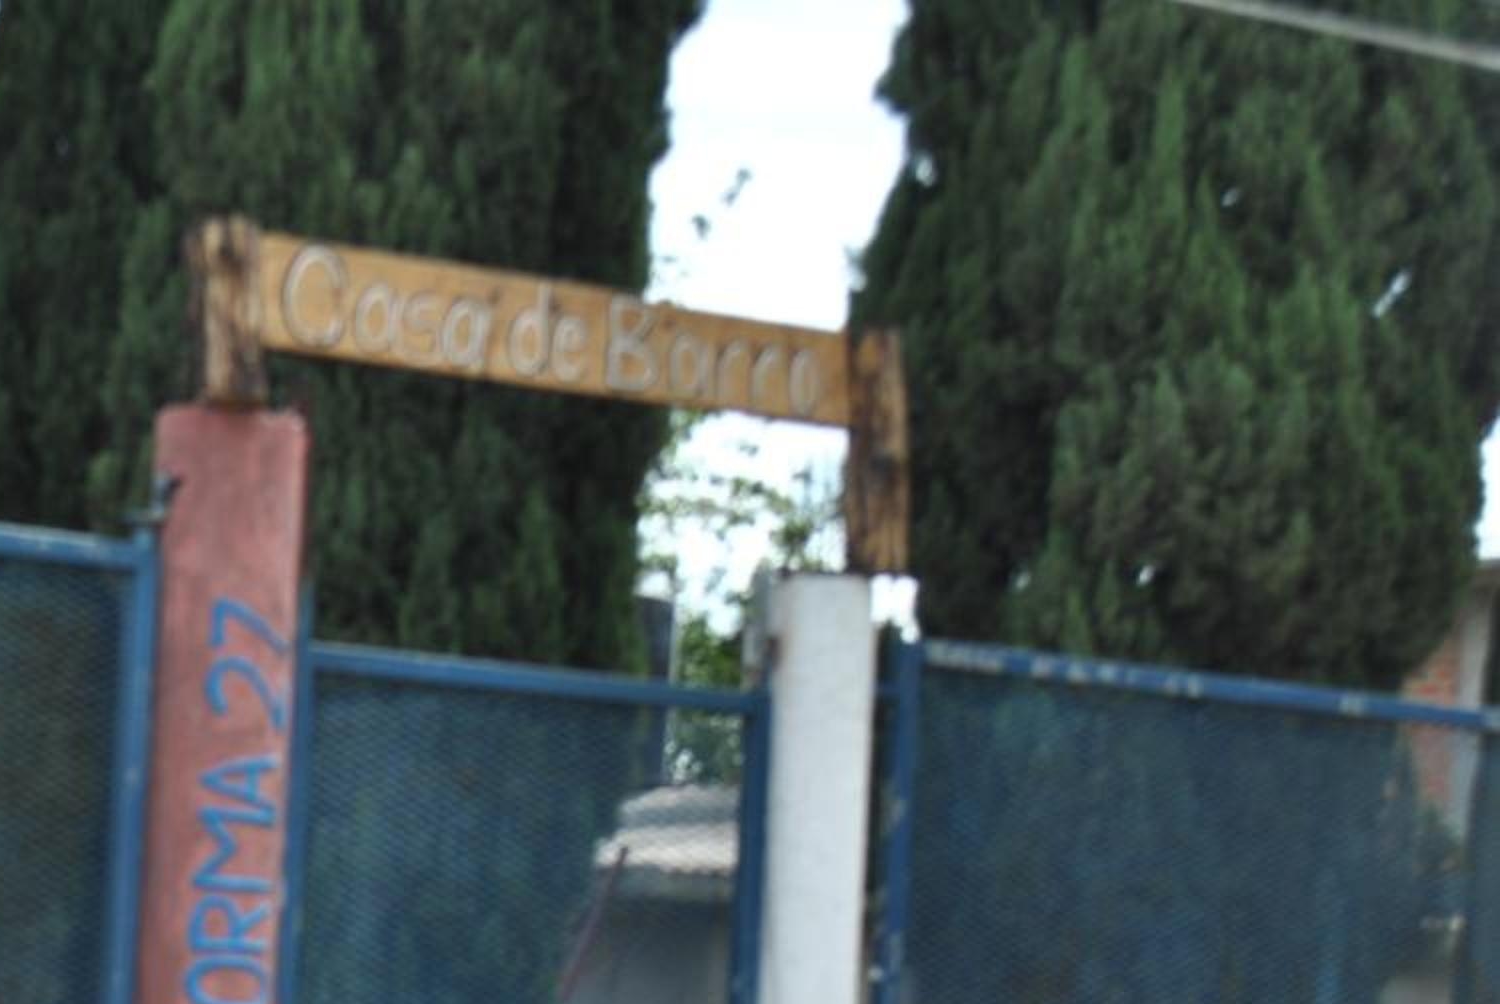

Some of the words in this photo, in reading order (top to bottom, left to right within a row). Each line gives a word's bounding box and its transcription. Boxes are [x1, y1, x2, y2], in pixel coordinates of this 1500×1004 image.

[283, 245, 493, 372] Casa
[508, 284, 588, 383] de
[606, 296, 822, 414] Barro
[206, 596, 291, 732] 27
